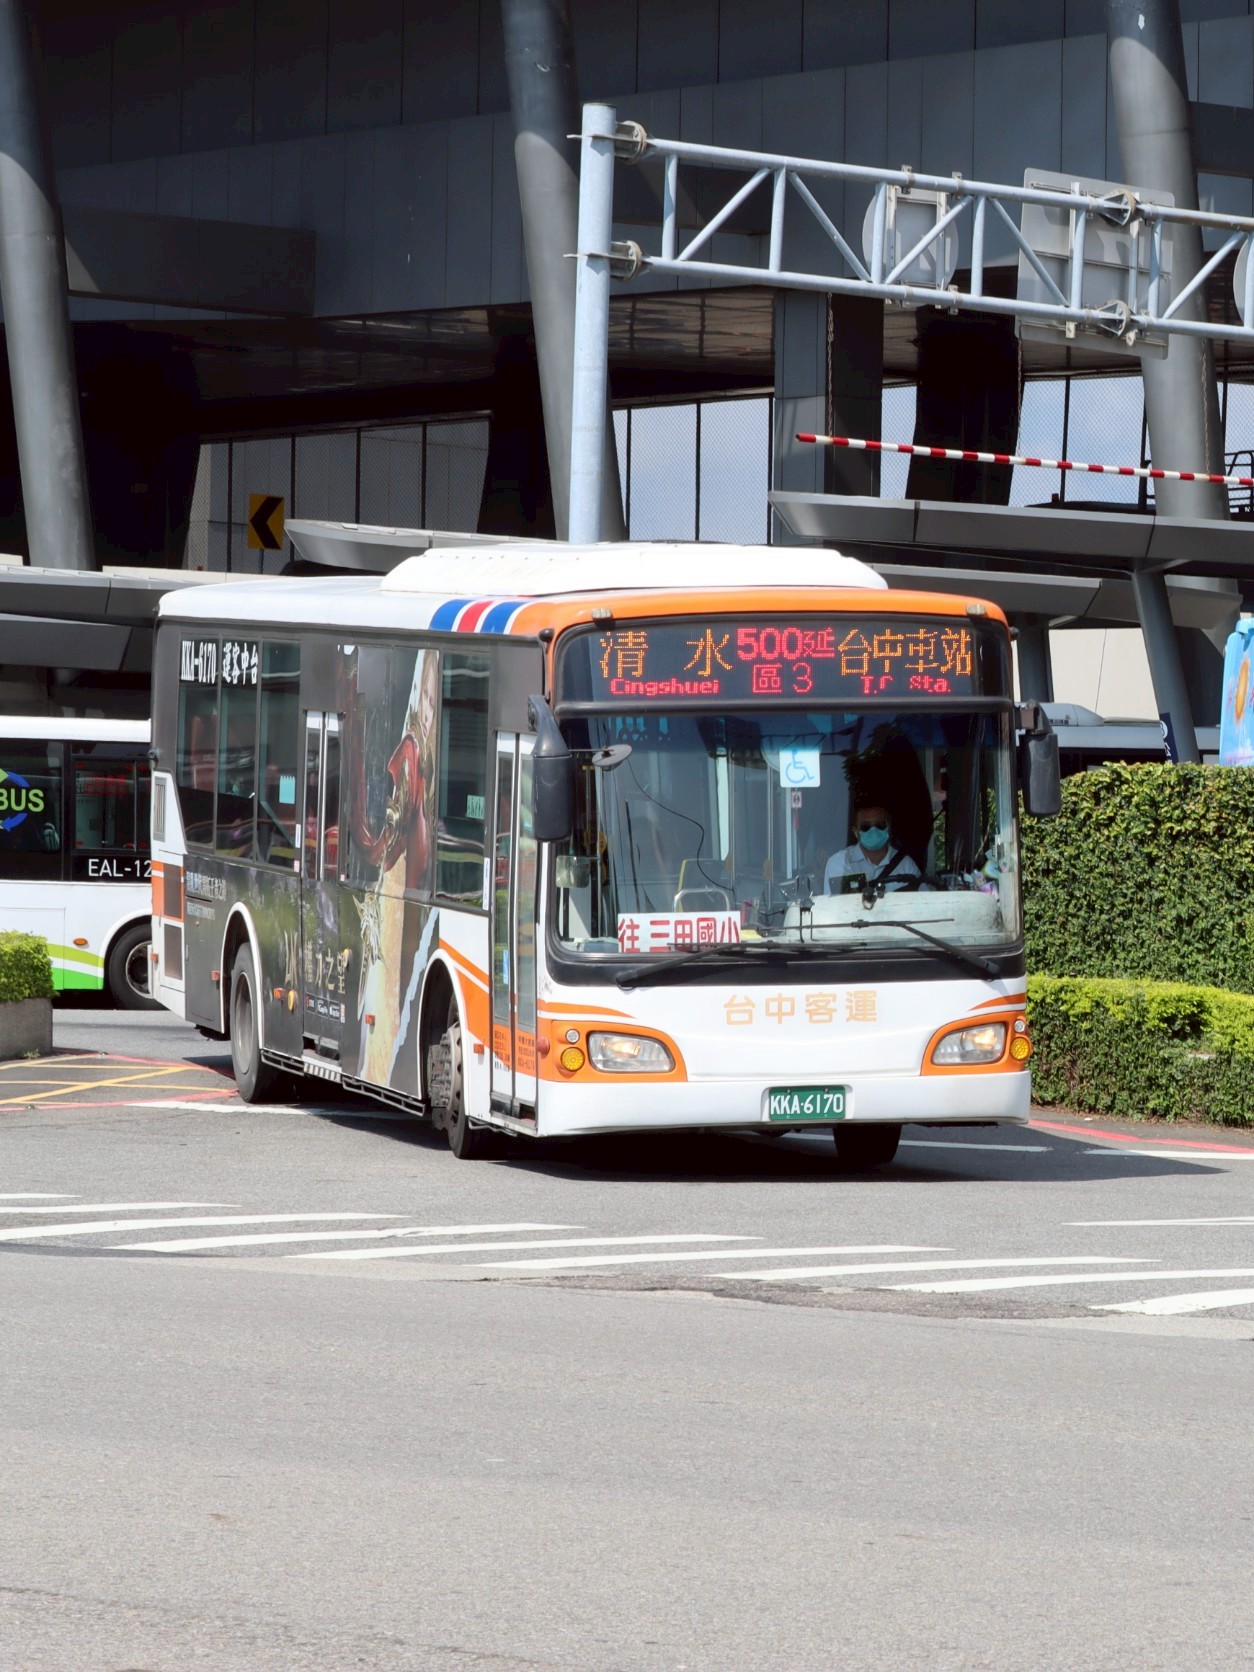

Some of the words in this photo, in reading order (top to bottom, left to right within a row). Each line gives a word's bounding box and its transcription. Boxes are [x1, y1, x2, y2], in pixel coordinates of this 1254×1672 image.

[181, 641, 217, 685] KKA-6170
[599, 631, 733, 678] 清水
[736, 627, 836, 661] 500延
[610, 678, 720, 696] Cingshuei
[723, 989, 878, 1026] 台中客運
